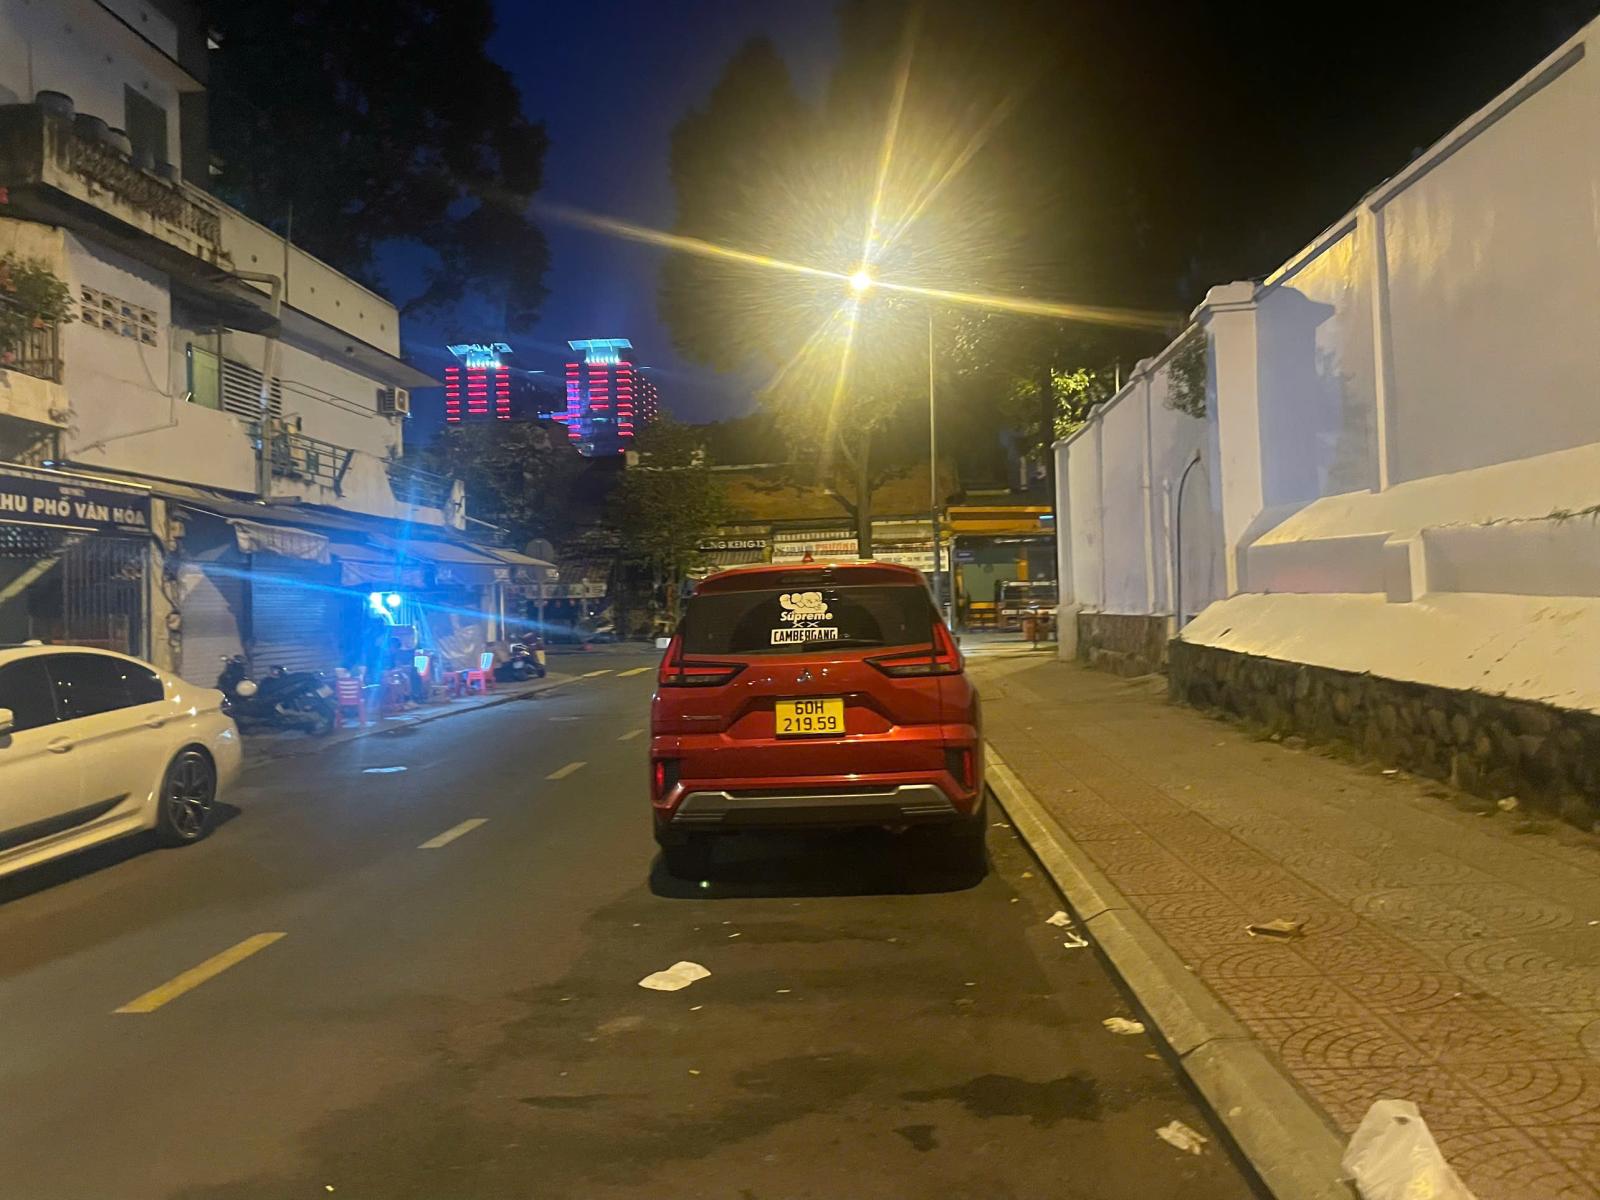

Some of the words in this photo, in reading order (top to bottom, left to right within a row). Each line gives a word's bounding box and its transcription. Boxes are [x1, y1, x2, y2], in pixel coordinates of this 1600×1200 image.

[0, 493, 27, 512] HU
[33, 495, 70, 517] PHỐ
[774, 629, 836, 642] CAMBERGANG
[794, 701, 824, 715] 60H
[783, 716, 836, 732] 219.59
